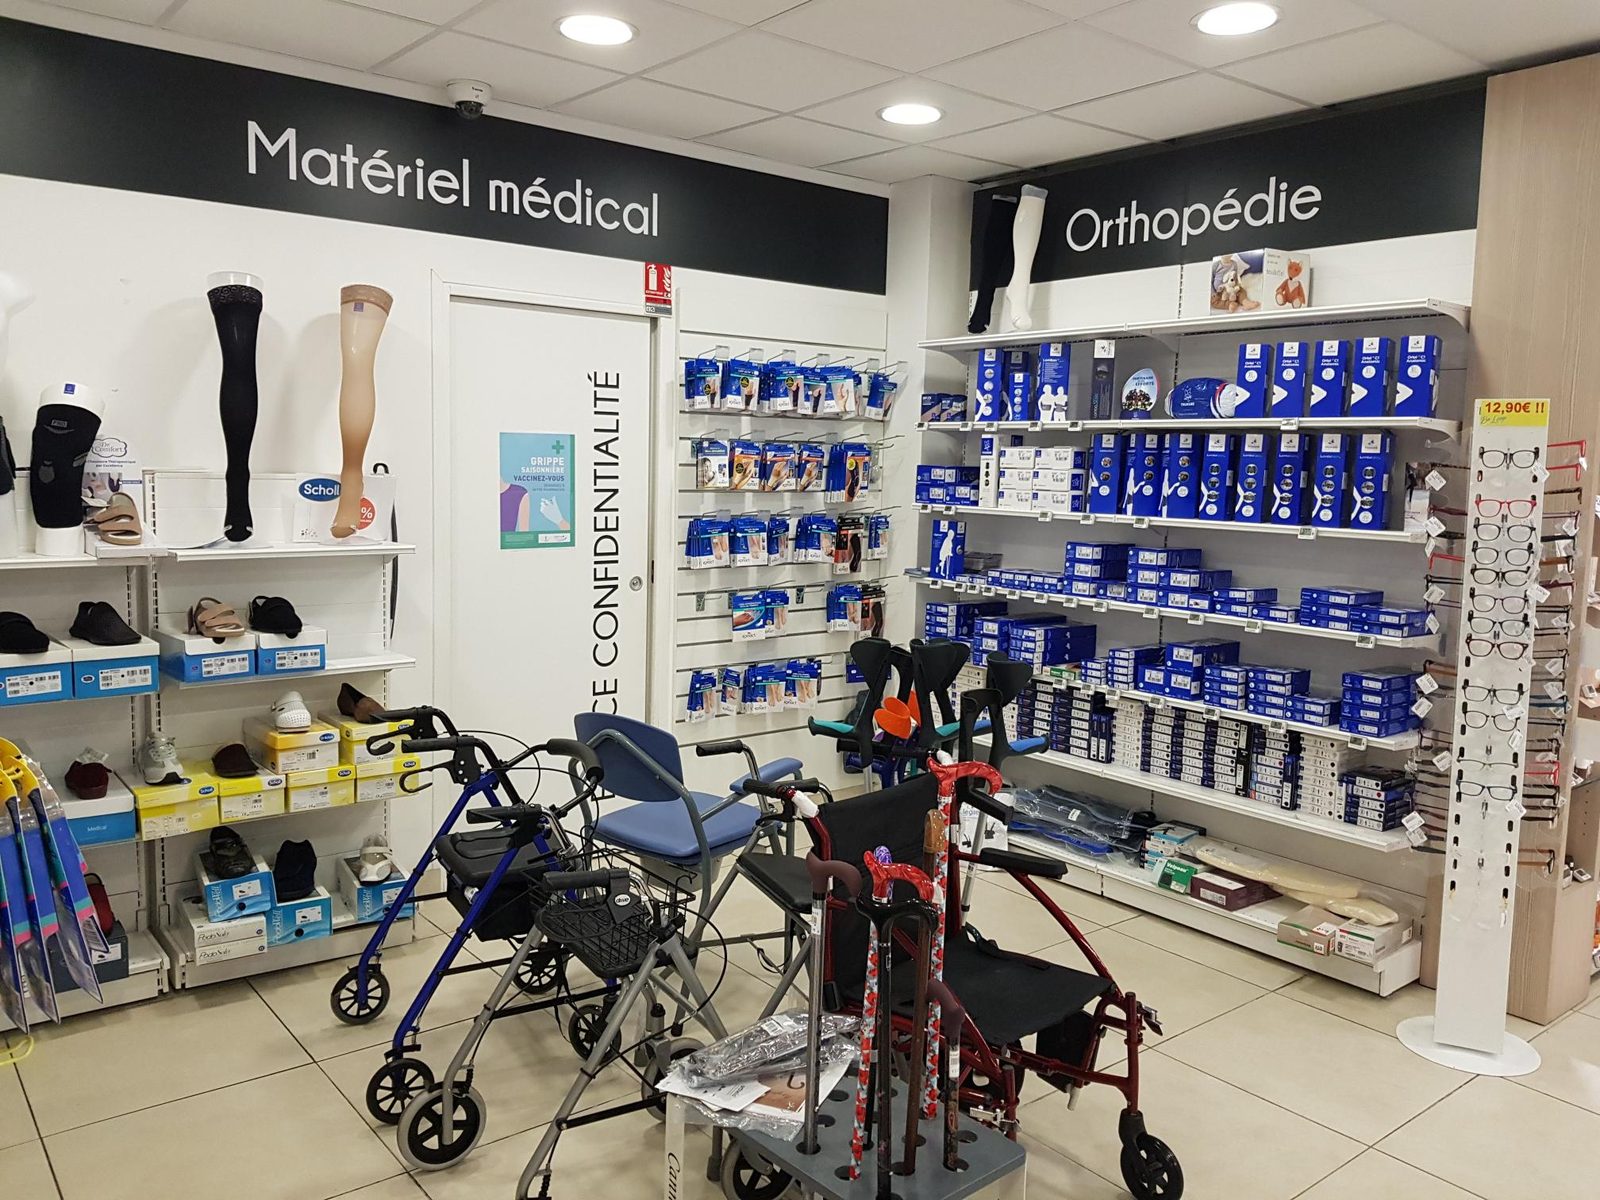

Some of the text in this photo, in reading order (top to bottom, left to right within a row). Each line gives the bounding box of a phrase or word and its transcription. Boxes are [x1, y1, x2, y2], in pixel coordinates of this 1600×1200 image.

[247, 120, 659, 237] Matériel médical
[1065, 175, 1323, 252] Orthopédie
[1485, 402, 1545, 415] 12,90€ !!
[530, 457, 565, 466] GRIPPE
[303, 484, 340, 496] Scholl
[587, 371, 620, 668] CONFIDENTIALITÉ
